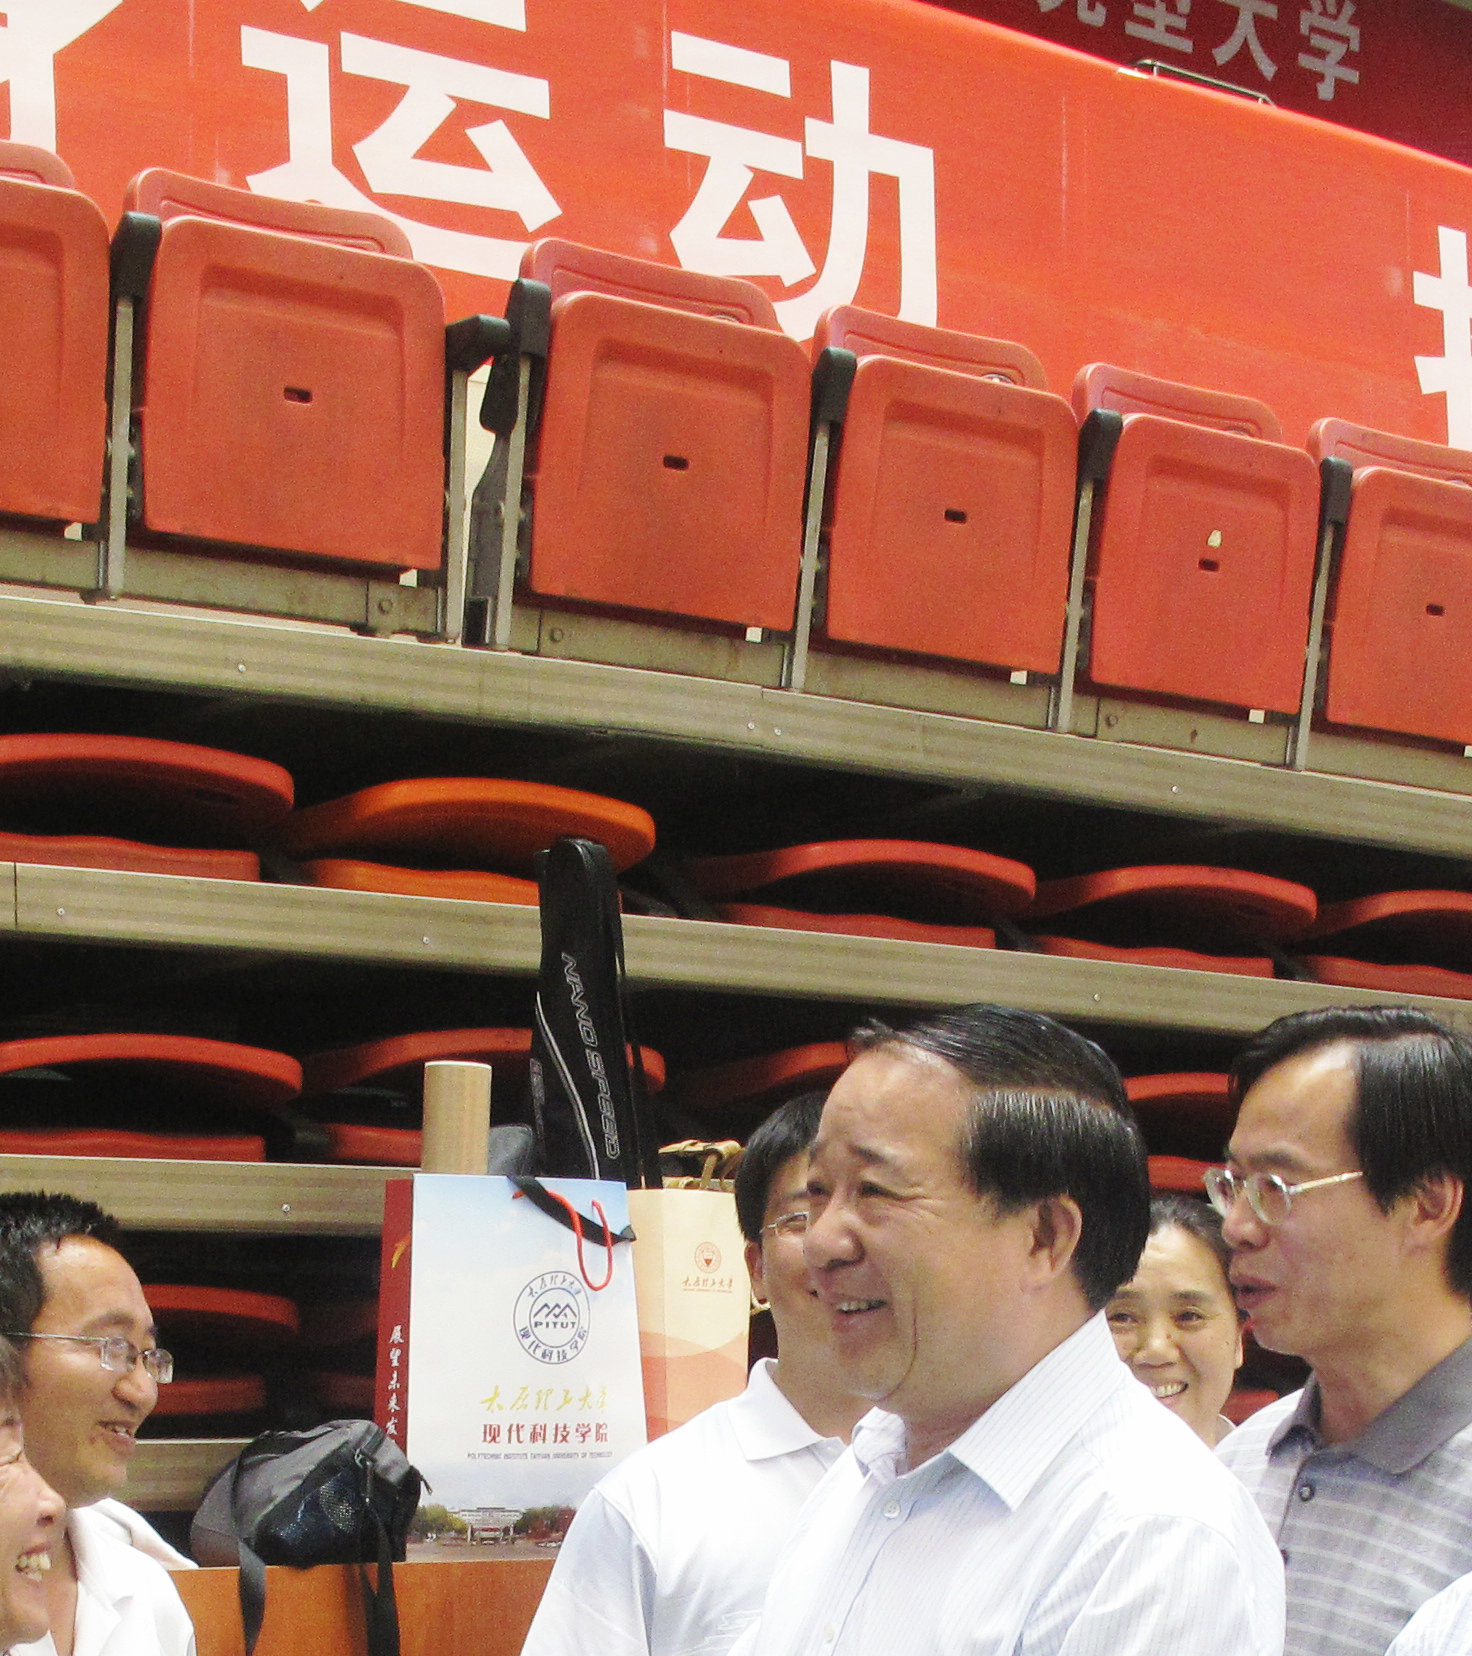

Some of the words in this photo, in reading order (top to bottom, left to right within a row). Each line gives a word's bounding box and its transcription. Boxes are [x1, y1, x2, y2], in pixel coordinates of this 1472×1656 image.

[1038, 0, 1361, 101] 大学
[561, 952, 598, 1048] NANO
[585, 1049, 621, 1160] SPEED
[533, 1321, 577, 1329] PITUT
[482, 1422, 609, 1444] 现代科技学院
